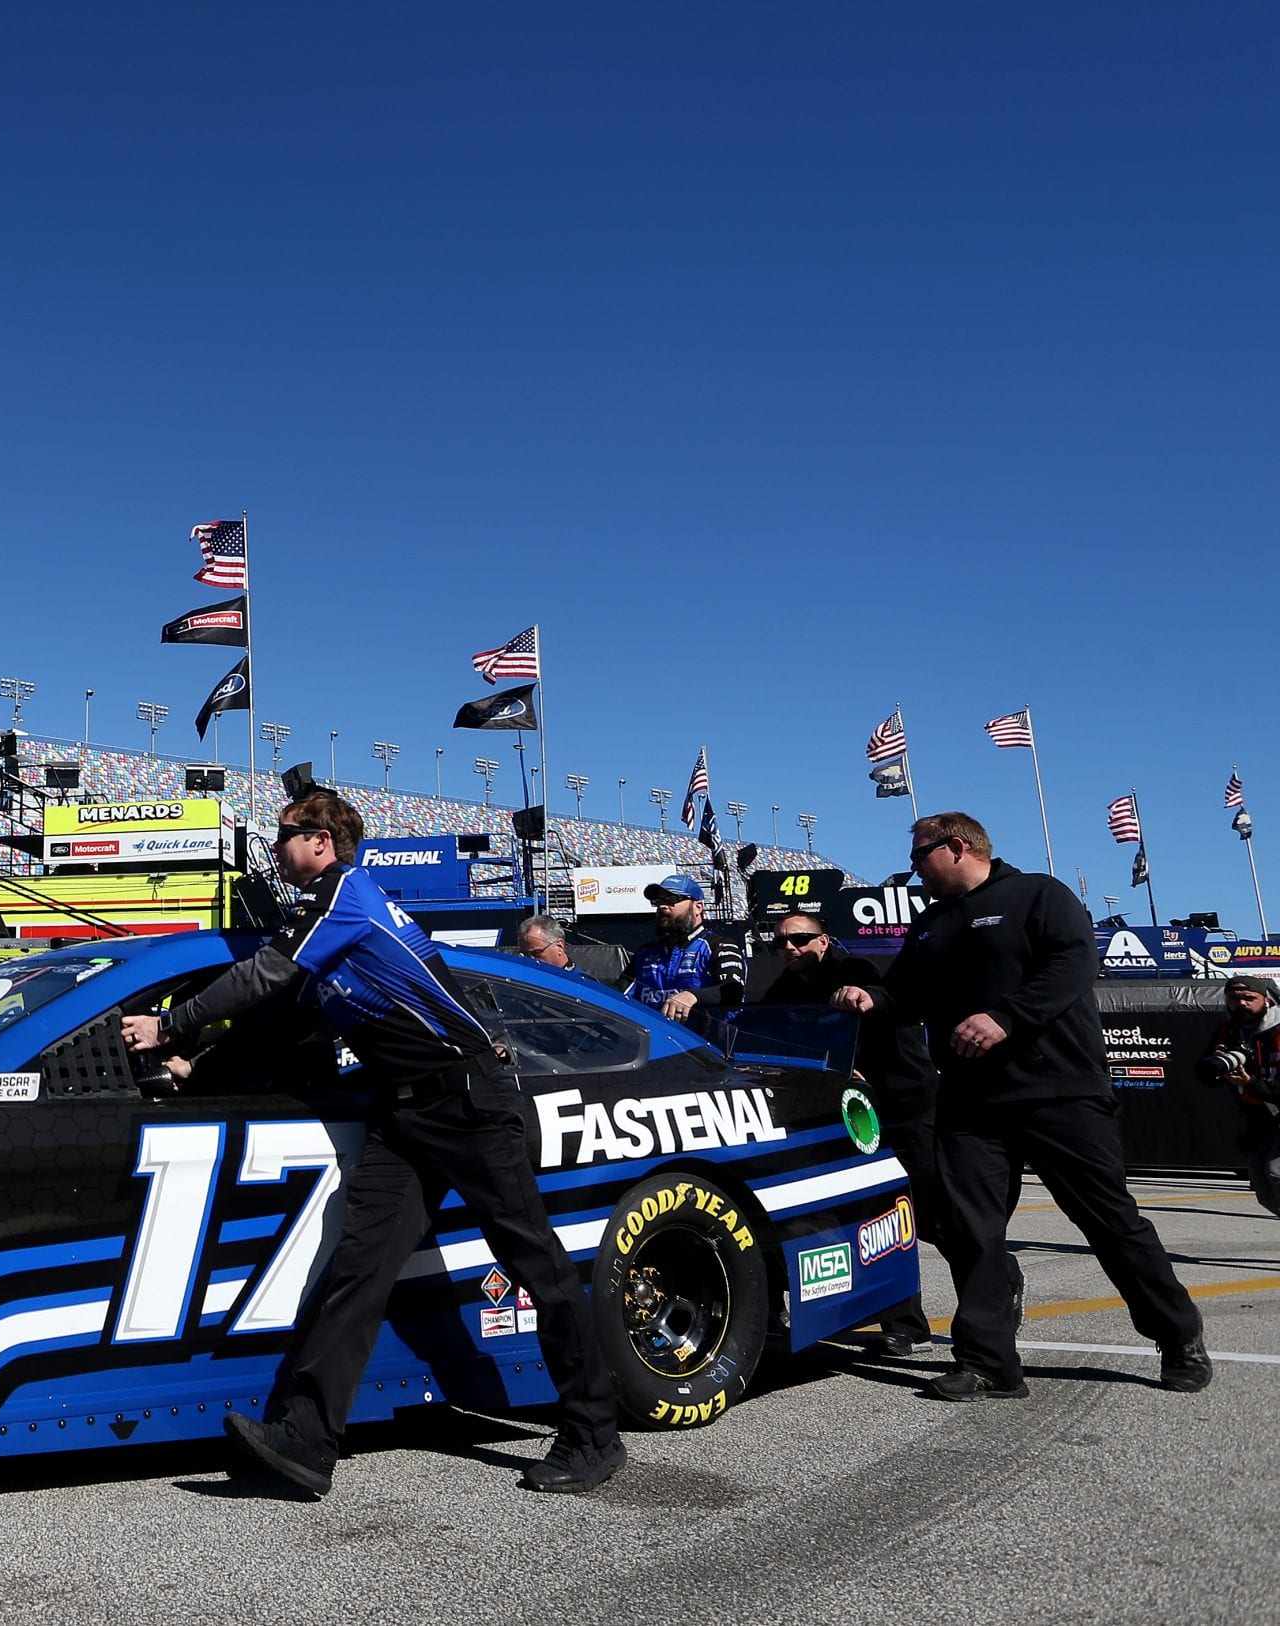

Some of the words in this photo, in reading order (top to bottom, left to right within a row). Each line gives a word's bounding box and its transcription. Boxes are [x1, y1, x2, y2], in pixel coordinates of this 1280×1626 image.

[193, 615, 239, 626] Motorcraft
[78, 803, 184, 823] MENARDS
[74, 843, 116, 854] Motorcraft
[146, 839, 179, 850] Quick
[182, 839, 214, 849] Lane
[361, 848, 442, 867] FASTENAL
[780, 875, 810, 896] 48
[858, 925, 873, 935] do
[874, 925, 885, 934] it
[1164, 952, 1187, 960] Hertz
[1234, 946, 1263, 956] AUTO
[6, 1088, 29, 1097] CAR
[533, 1088, 787, 1168] FASTENAL
[111, 1120, 342, 1345] 17
[803, 1249, 849, 1282] MSA
[802, 1287, 811, 1297] The
[811, 1284, 827, 1298] Safety
[828, 1280, 851, 1294] Company
[484, 1314, 512, 1325] CHAMPION
[649, 1389, 727, 1425] EAGLE
